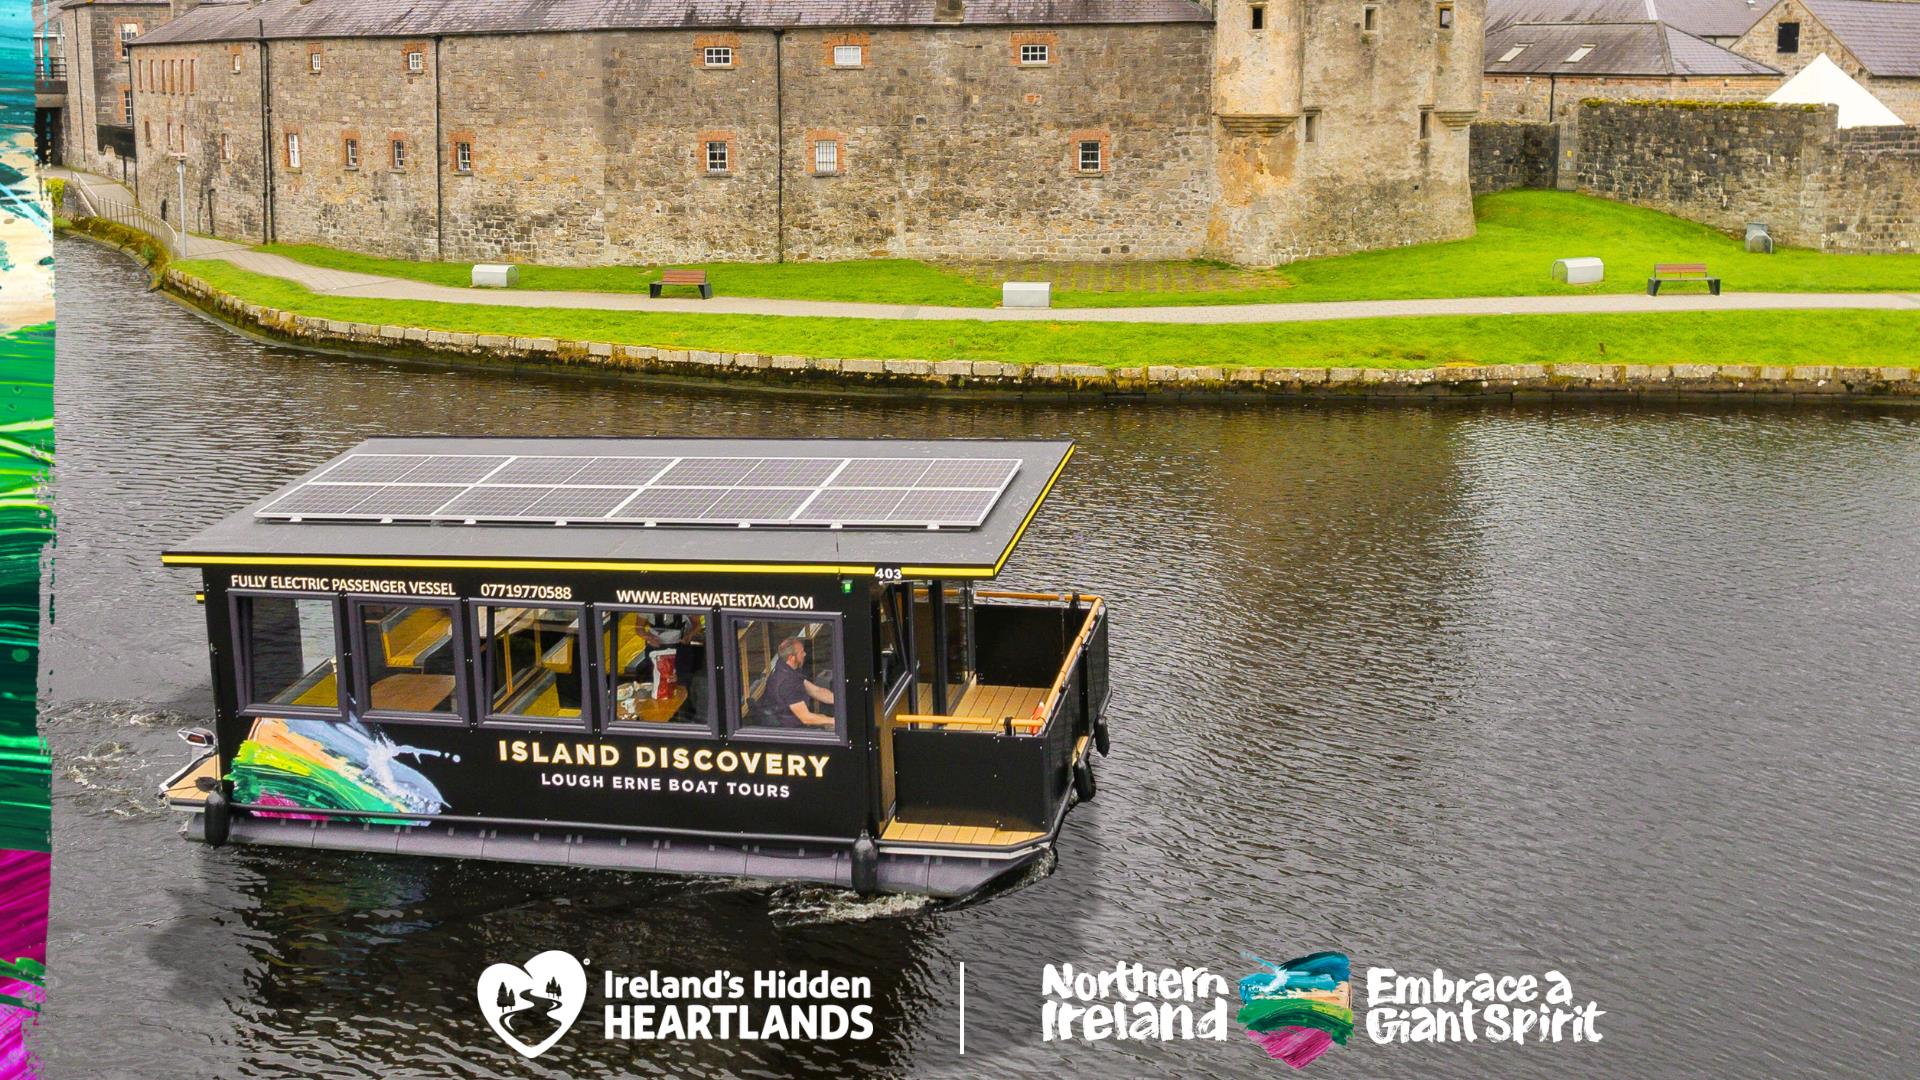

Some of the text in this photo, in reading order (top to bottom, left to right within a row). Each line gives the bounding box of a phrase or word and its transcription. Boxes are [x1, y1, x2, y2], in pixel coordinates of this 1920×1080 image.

[874, 567, 902, 580] 403
[230, 574, 457, 596] FULLY ELECTRIC PASSENGER VESSEL
[480, 583, 572, 600] 07719770588
[616, 589, 814, 610] WWW.ERNEWATERTAXI.COM
[498, 740, 830, 778] ISLAND DISCOVERY
[541, 773, 790, 798] LOUGH ERNE BOAT TOURS
